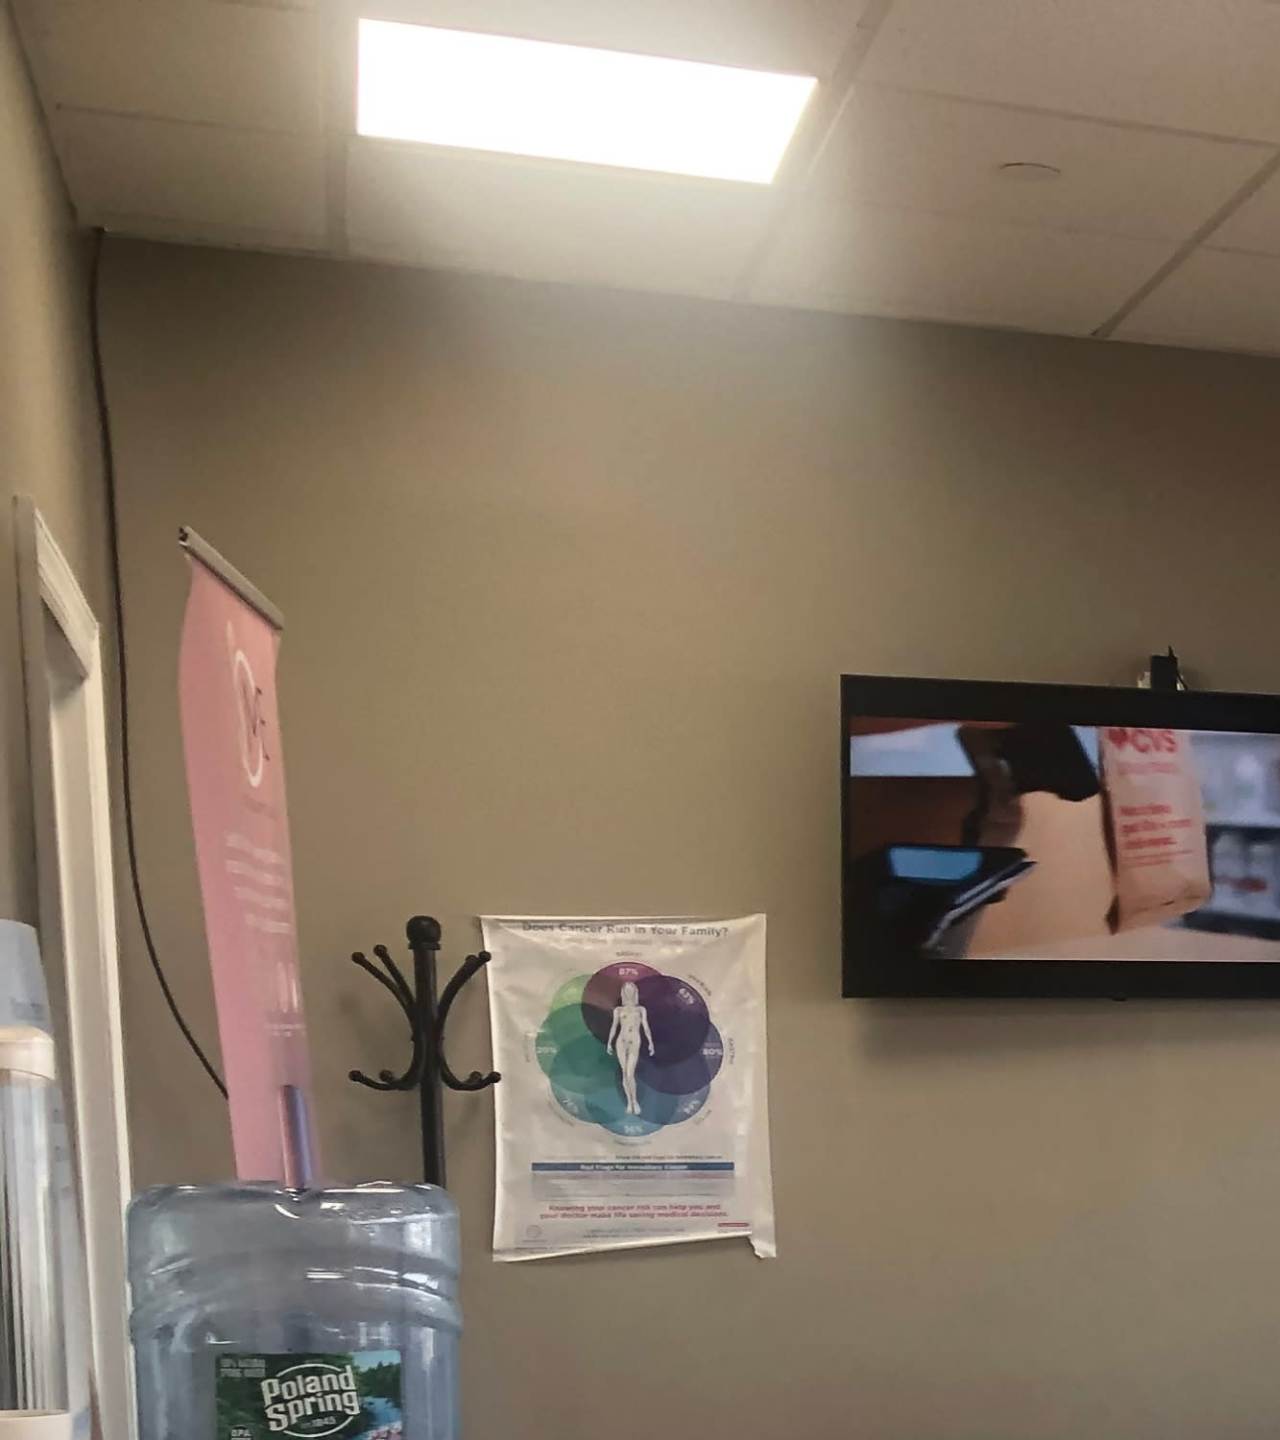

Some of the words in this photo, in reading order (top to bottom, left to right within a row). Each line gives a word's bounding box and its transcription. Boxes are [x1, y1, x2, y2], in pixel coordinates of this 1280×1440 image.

[558, 923, 602, 933] Cancer
[606, 924, 631, 934] Run
[634, 925, 647, 934] in
[651, 925, 677, 935] Your
[682, 926, 729, 937] Family?
[261, 1365, 357, 1407] Poland
[265, 1391, 361, 1432] Spring
